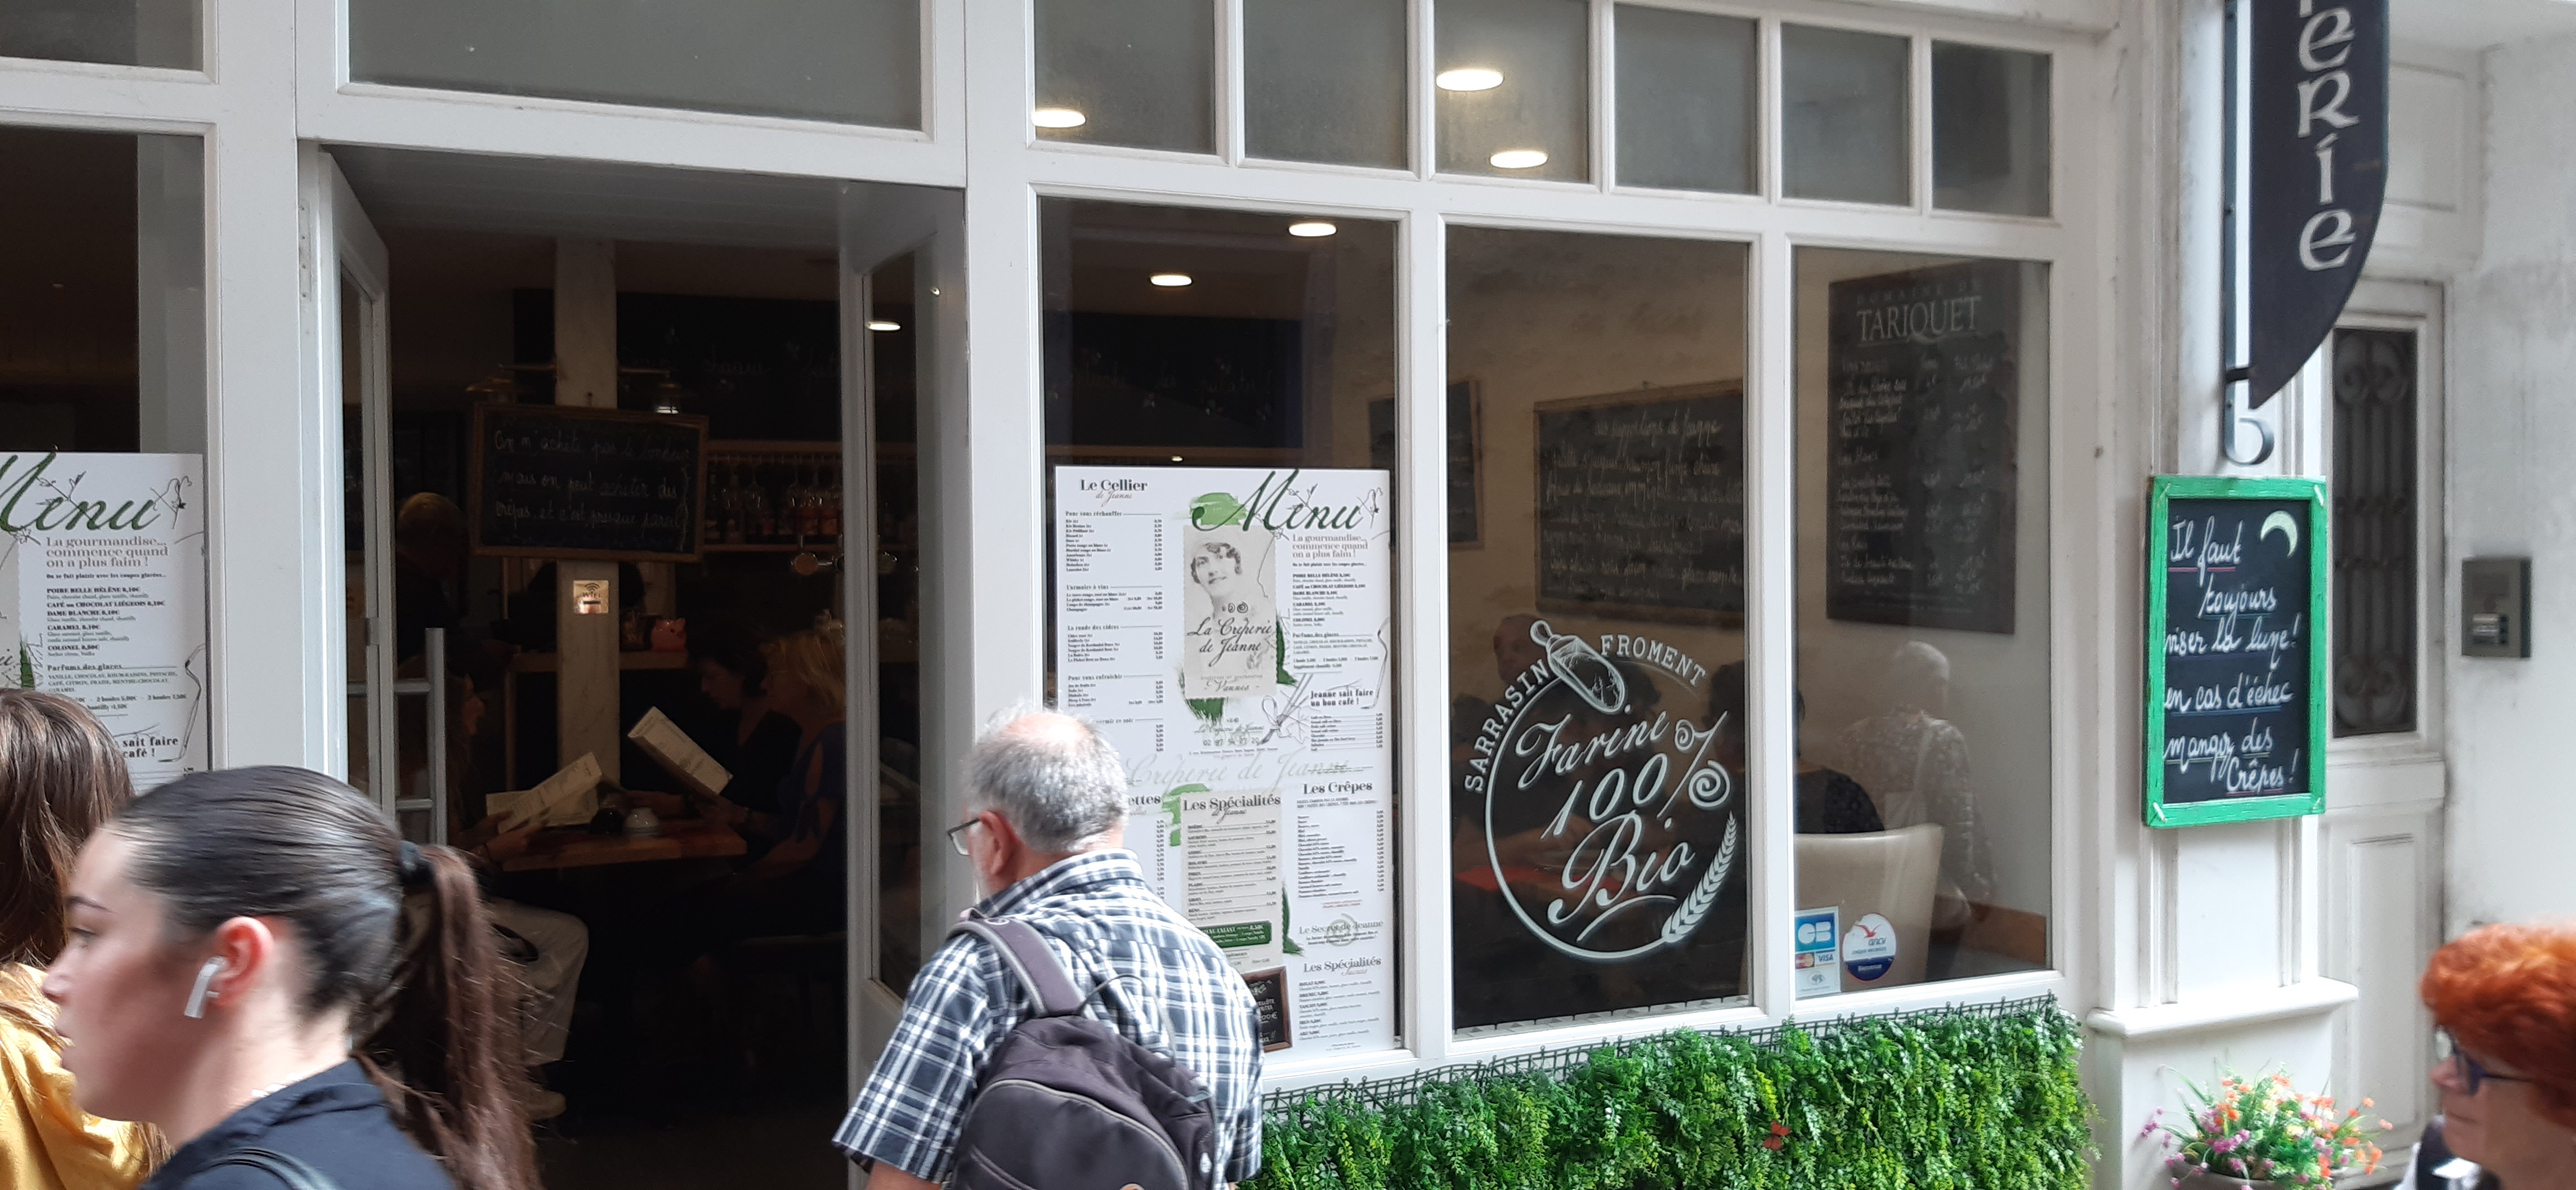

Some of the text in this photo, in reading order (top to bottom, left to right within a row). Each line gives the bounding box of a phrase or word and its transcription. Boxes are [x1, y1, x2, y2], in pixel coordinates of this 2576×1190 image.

[1856, 295, 1982, 343] TARIQUET
[1081, 479, 1148, 491] Le Cellier
[1192, 469, 1363, 531] Menu
[46, 537, 63, 547] La
[46, 546, 169, 558] commence quand
[1341, 541, 1368, 551] quand
[2170, 514, 2244, 587] Il faut
[46, 559, 64, 568] on
[67, 559, 75, 568] a
[79, 557, 107, 570] plus
[111, 557, 141, 567] faim
[1313, 550, 1330, 559] plus
[2198, 573, 2279, 630] toujours
[1187, 616, 1212, 636] La
[2164, 626, 2208, 655] viser
[2210, 618, 2244, 653] la
[1200, 635, 1262, 667] de Jeanne
[1599, 634, 1707, 687] FROMENT
[1310, 690, 1337, 700] Jeanne
[2164, 672, 2294, 715] en cas d'échec
[1464, 657, 1550, 794] SARRASIN
[2241, 716, 2273, 753] des
[122, 735, 179, 747] sait faire
[1515, 709, 1669, 790] Farine
[1540, 709, 1731, 841] 100%
[2226, 756, 2284, 795] Crêpes
[1303, 781, 1373, 794] Les Crêpes
[1183, 794, 1281, 811] Les Spécialités
[1546, 809, 1696, 925] Bio
[1341, 922, 1351, 931] de
[1798, 922, 1831, 945] CB
[1303, 956, 1382, 972] Les Spécialités
[1819, 953, 1834, 962] VISA
